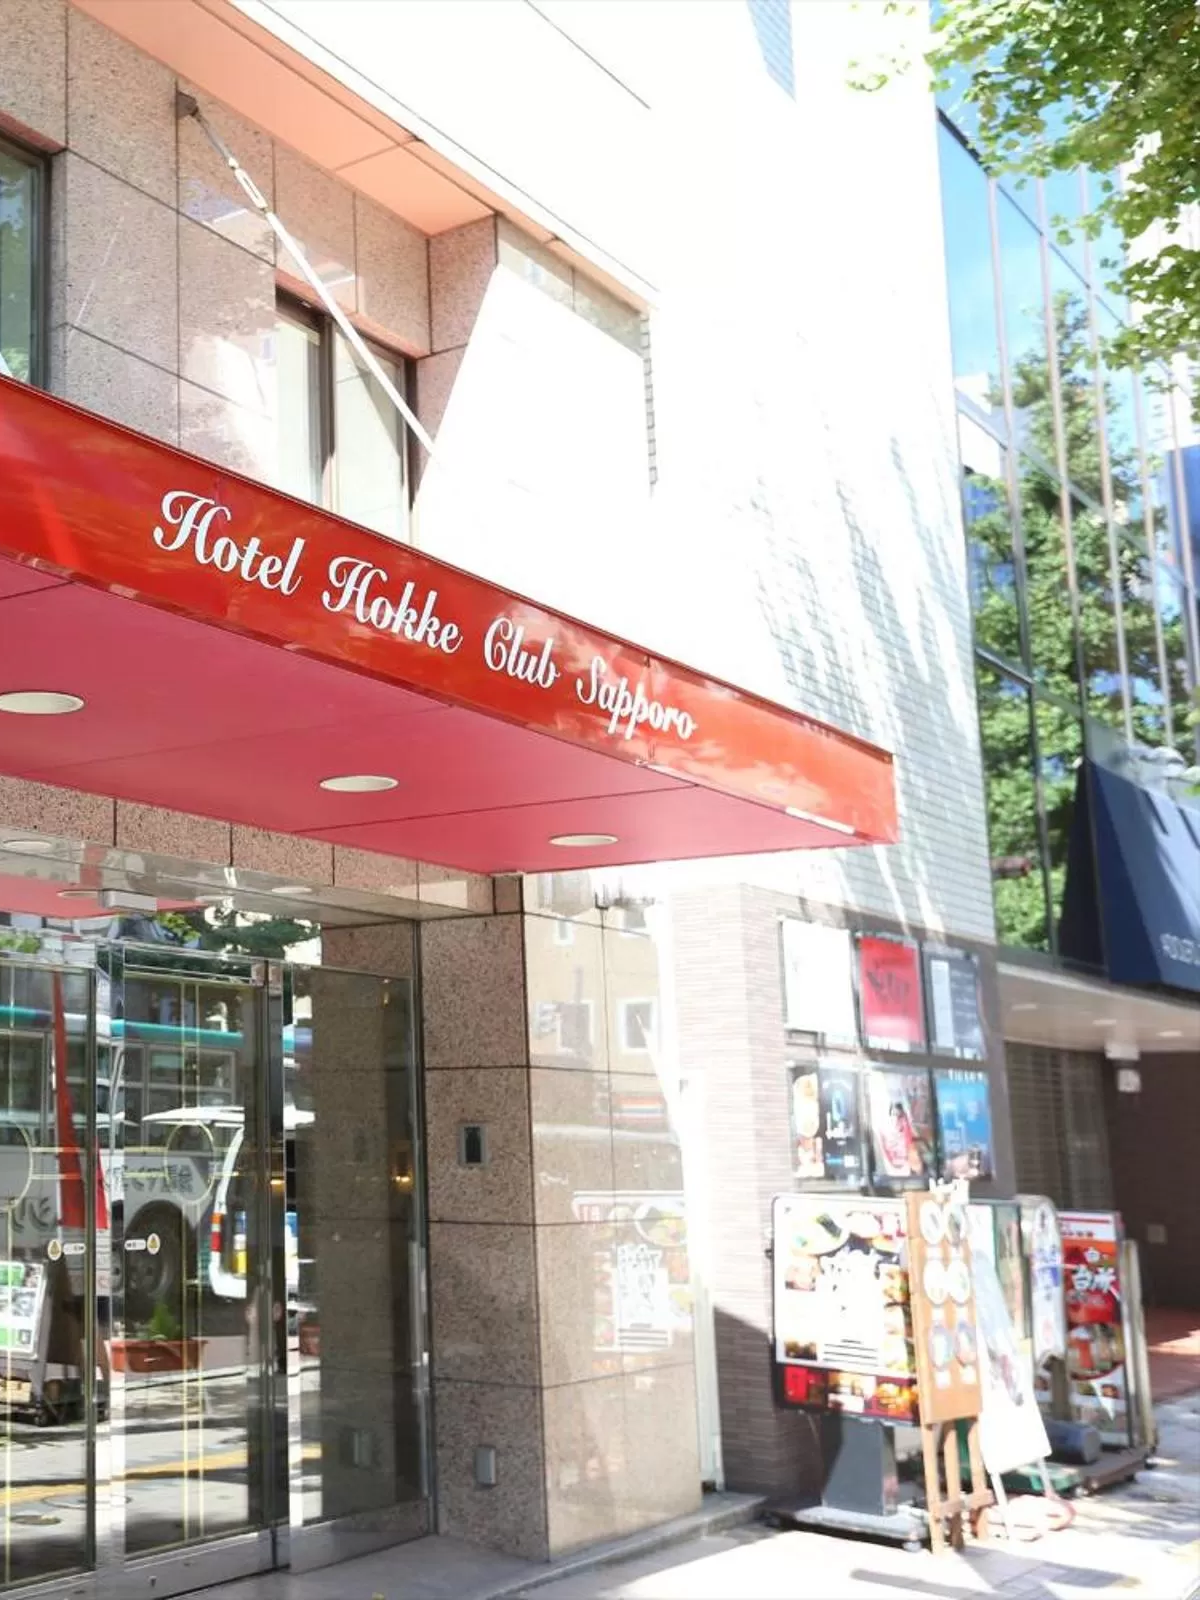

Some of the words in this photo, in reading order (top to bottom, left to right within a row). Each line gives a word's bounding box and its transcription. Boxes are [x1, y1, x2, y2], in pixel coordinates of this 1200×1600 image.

[152, 489, 306, 595] Hotel
[322, 555, 464, 654] Hokke
[483, 617, 562, 689] Club
[575, 655, 698, 740] Sapporo
